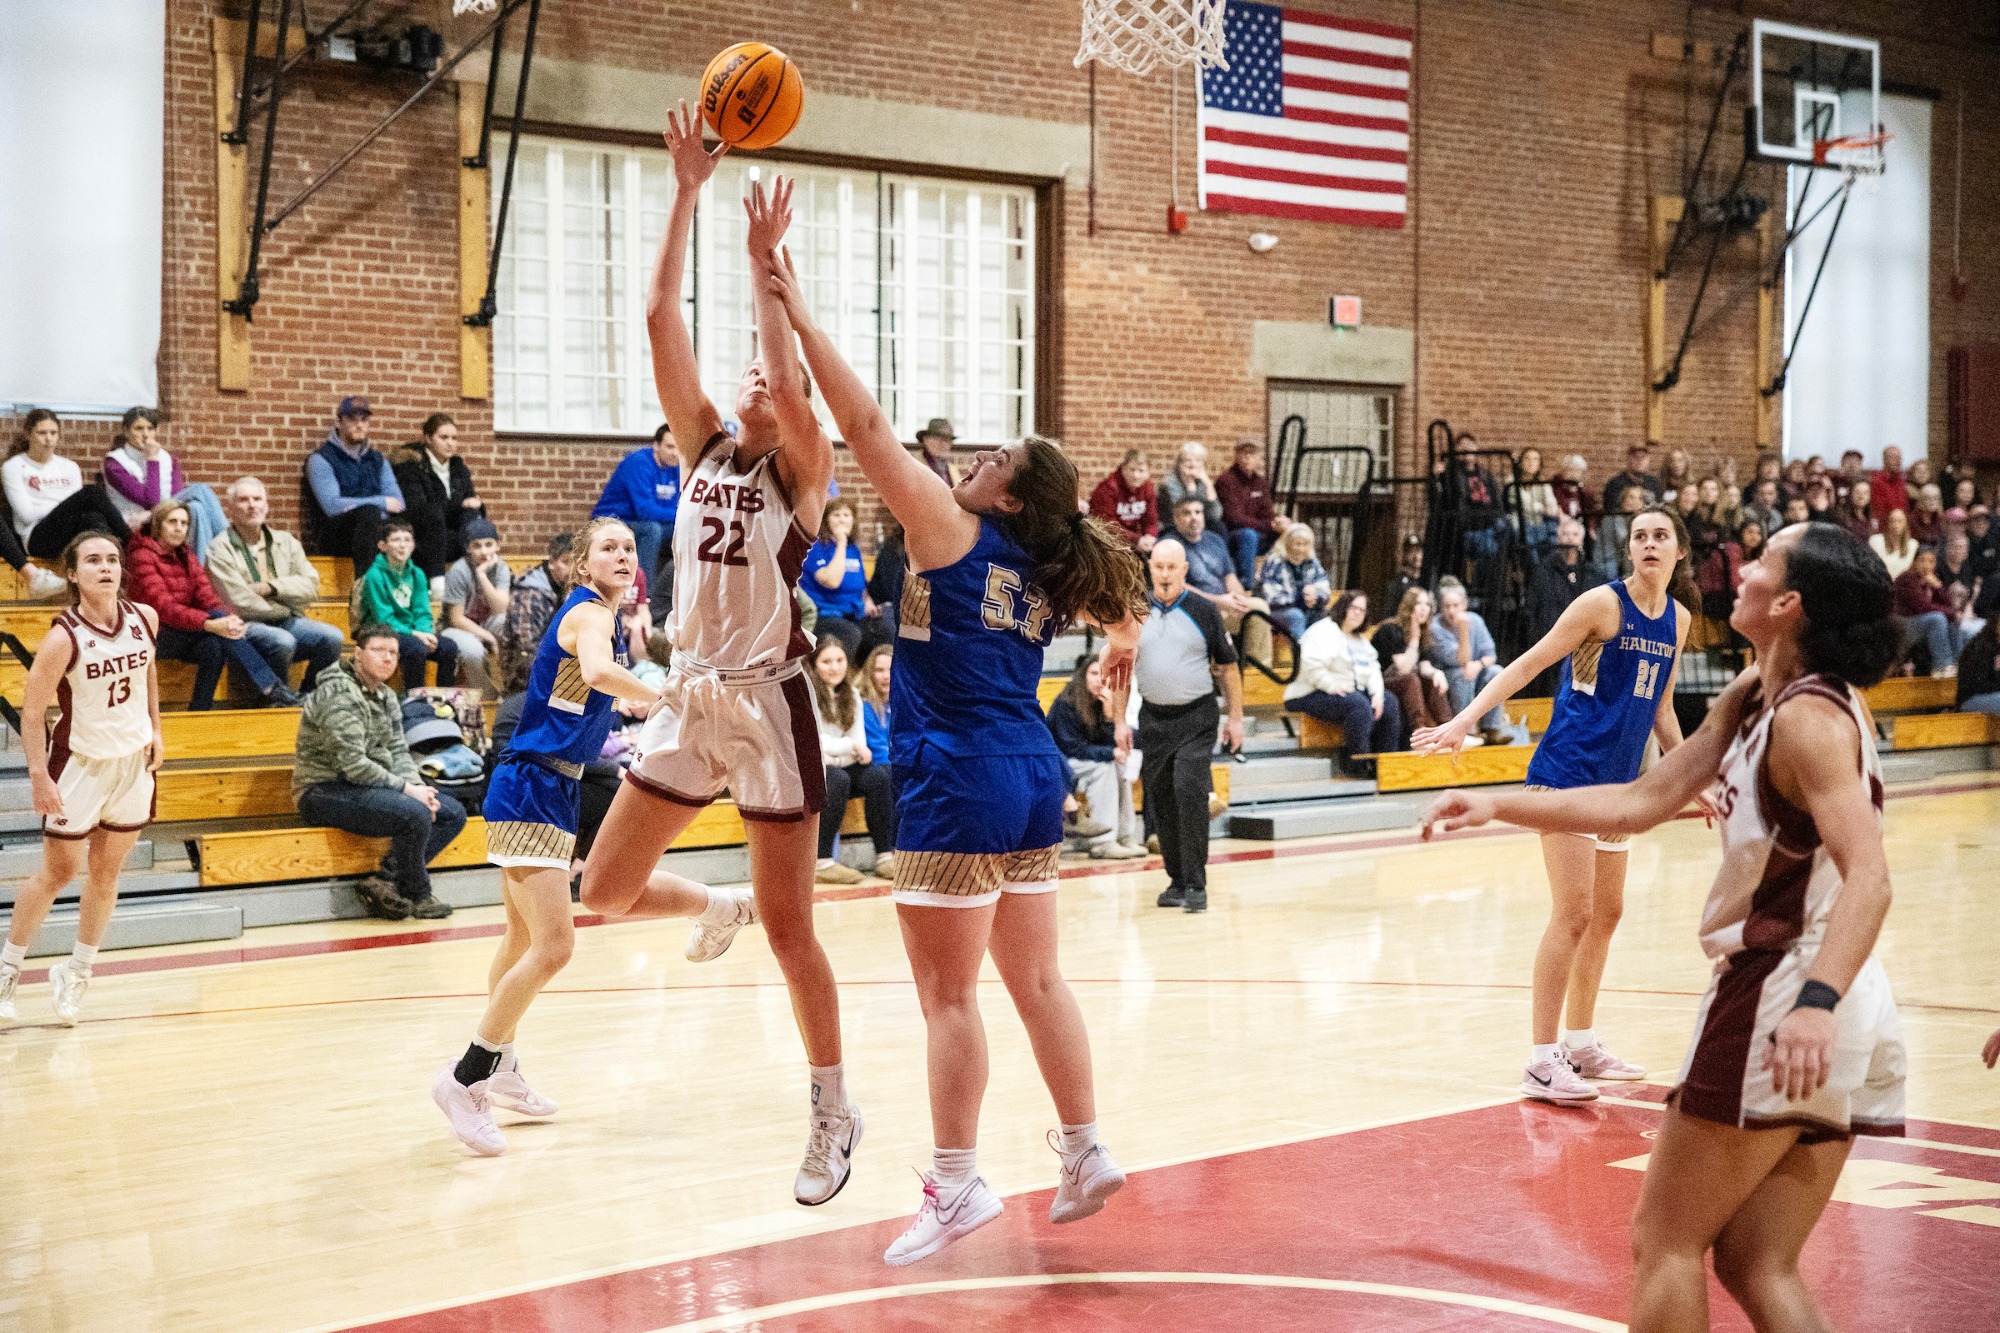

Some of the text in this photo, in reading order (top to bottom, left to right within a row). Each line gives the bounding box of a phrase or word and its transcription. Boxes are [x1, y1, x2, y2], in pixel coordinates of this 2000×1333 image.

[689, 478, 765, 514] BATES
[697, 516, 749, 567] 22
[980, 562, 1054, 643] 53
[86, 650, 148, 680] BATES
[1633, 659, 1661, 700] 21
[107, 676, 131, 709] 13
